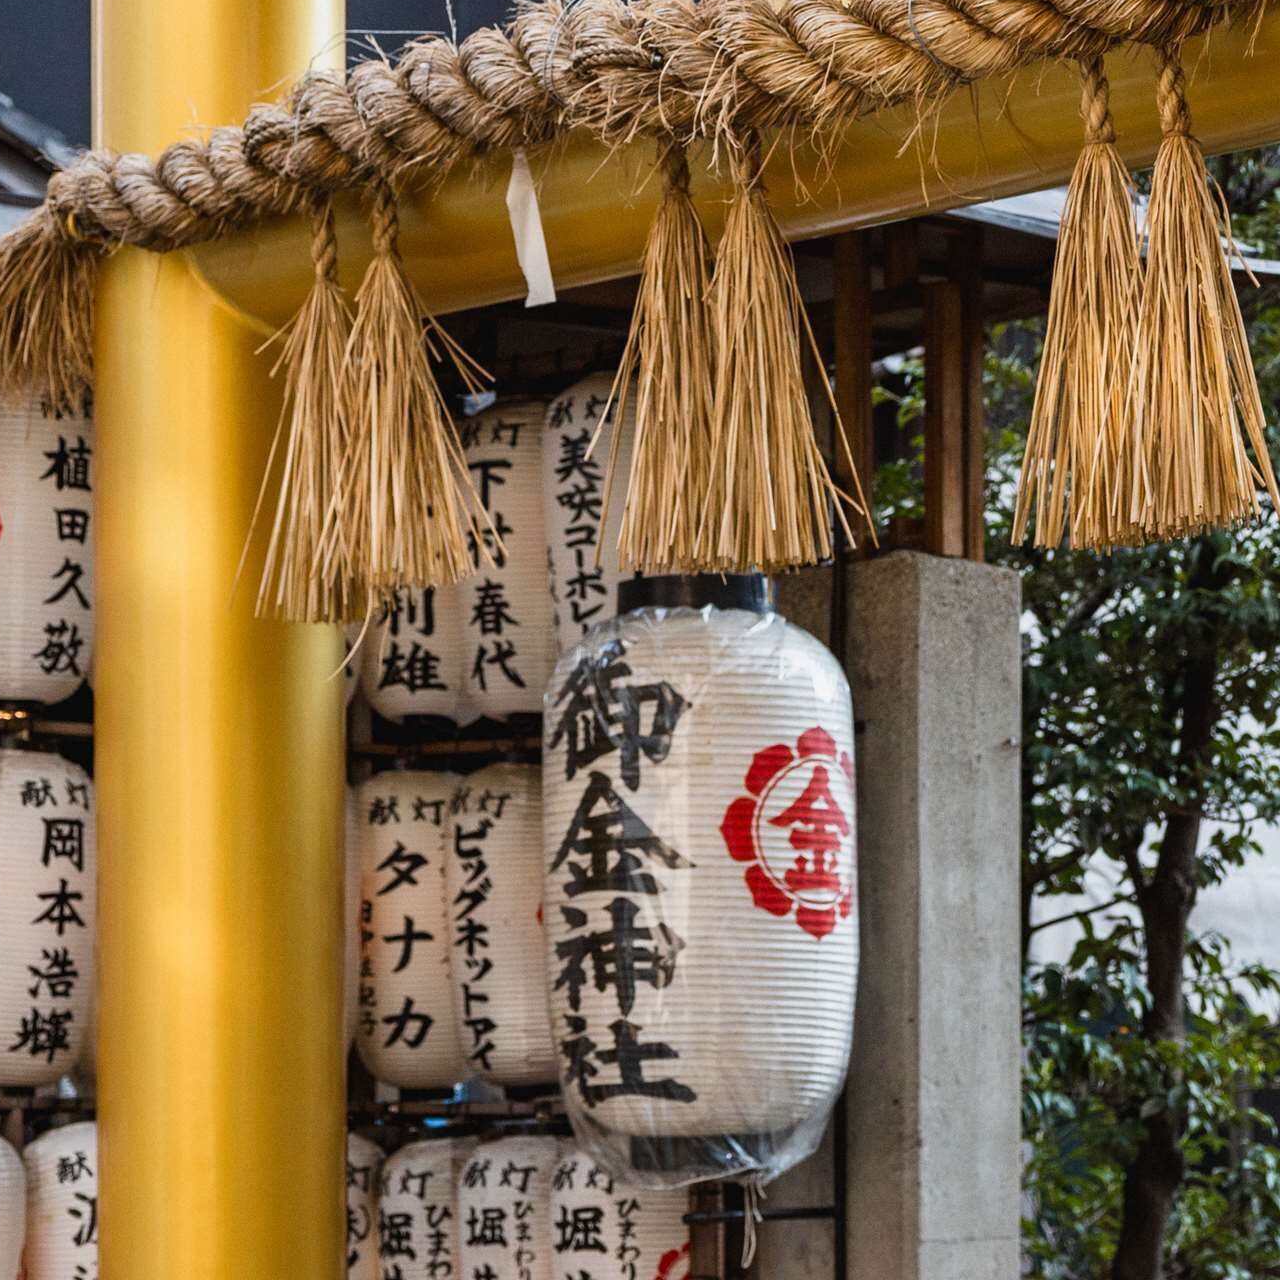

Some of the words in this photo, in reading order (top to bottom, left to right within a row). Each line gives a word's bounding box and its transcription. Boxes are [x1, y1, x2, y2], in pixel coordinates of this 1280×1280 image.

[468, 459, 527, 692] 下村春代
[20, 777, 91, 811] 献灯
[549, 639, 699, 1109] 御金神社
[767, 765, 851, 892] 金
[9, 817, 87, 1064] 岡本浩輝
[375, 841, 437, 1050] タナカ
